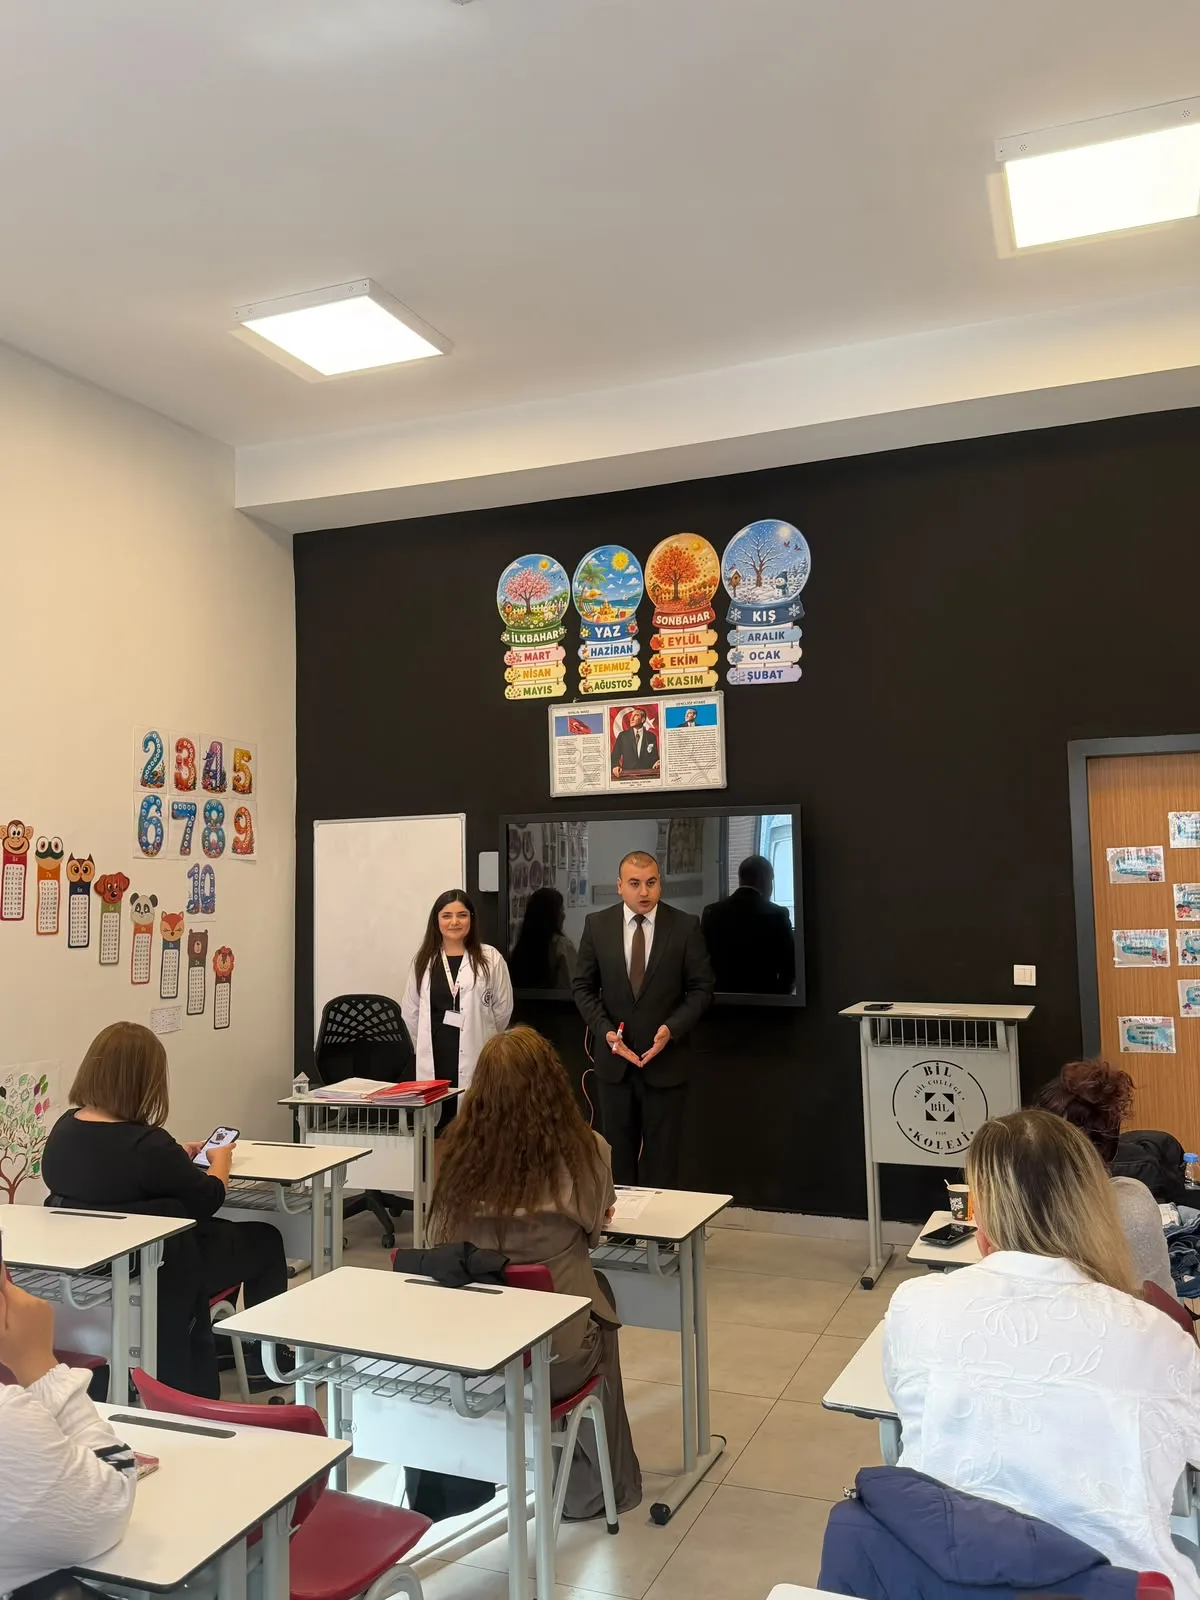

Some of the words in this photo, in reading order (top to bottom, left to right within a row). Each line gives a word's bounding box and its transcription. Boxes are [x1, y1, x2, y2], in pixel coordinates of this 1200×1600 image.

[655, 611, 710, 626] SONBAHAR
[752, 609, 776, 624] KIŞ
[511, 630, 559, 643] İLKBAHAR
[594, 625, 622, 638] YAZ
[747, 631, 785, 642] ARALIK
[668, 633, 702, 647] EYLÜL
[524, 650, 551, 661] MART
[591, 644, 633, 657] HAZİRAN
[749, 650, 781, 661] OCAK
[670, 654, 698, 667] EKİM
[523, 668, 551, 679] NİSAN
[594, 662, 631, 673] TEMMUZ
[667, 675, 704, 686] KASIM
[747, 670, 783, 682] ŞUBAT
[523, 685, 553, 696] MAYIS
[594, 679, 633, 690] AĞUSTOS
[140, 730, 165, 788] 2
[173, 737, 197, 792] 3
[201, 741, 227, 794] 4
[232, 747, 253, 795] 5
[138, 794, 164, 857] 6
[171, 801, 197, 856] 7
[201, 799, 225, 858] 8
[231, 806, 254, 855] 9
[186, 862, 216, 915] 10
[923, 1062, 952, 1078] BİL
[930, 1101, 950, 1112] BİL
[913, 1131, 970, 1150] KOLEJİ
